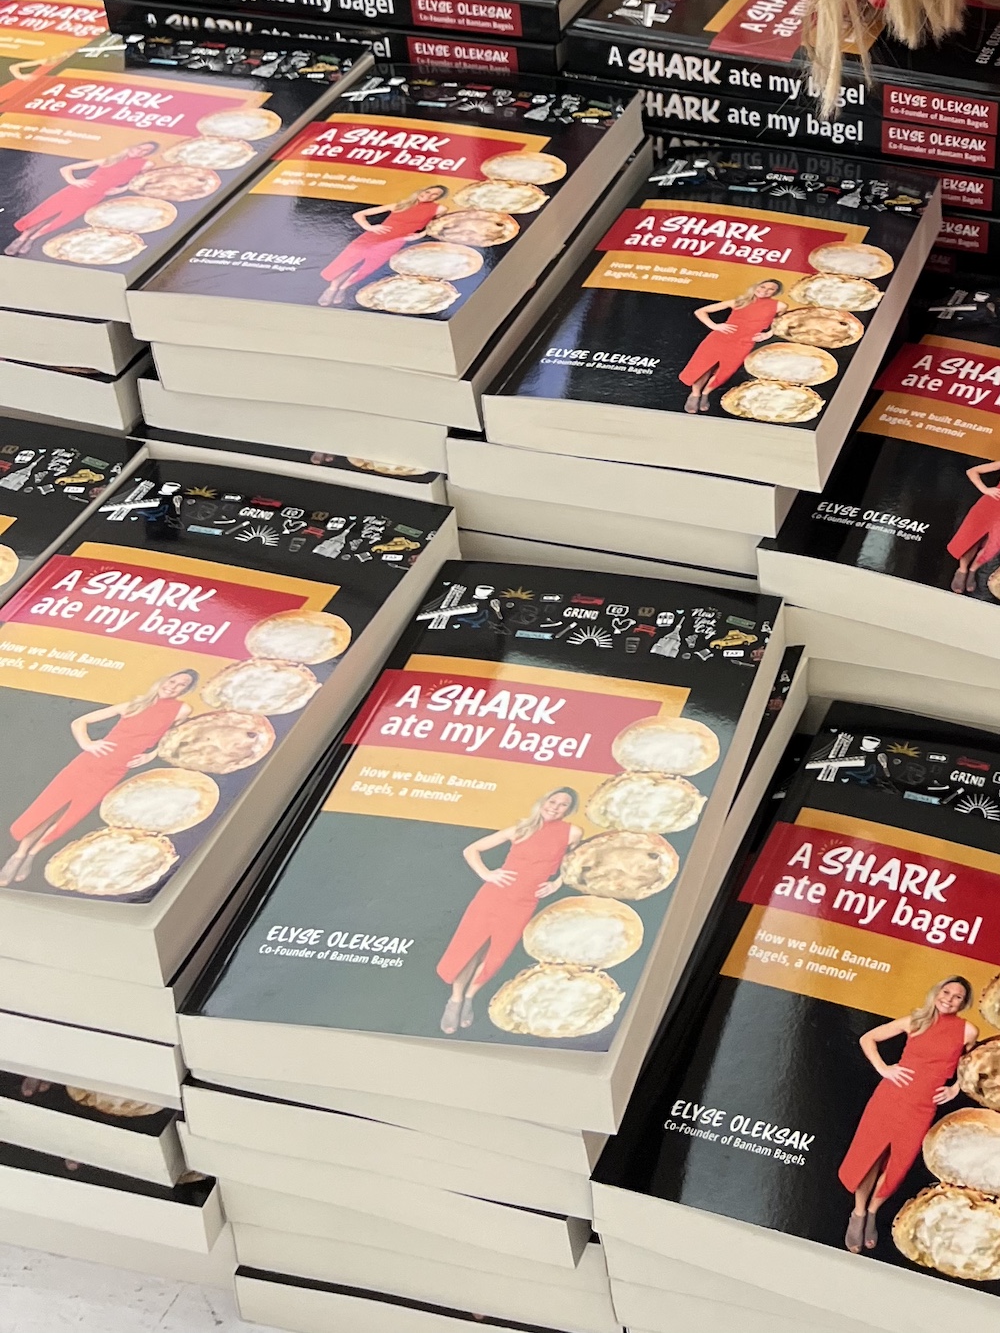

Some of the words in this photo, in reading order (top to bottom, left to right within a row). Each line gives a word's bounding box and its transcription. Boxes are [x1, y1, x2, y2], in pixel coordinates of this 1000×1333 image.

[0, 2, 19, 15] A
[17, 2, 108, 23] SHARK
[0, 14, 20, 26] te
[19, 17, 57, 32] my
[54, 19, 107, 37] bage
[457, 2, 513, 20] OLEKSAK
[739, 22, 768, 34] A
[772, 16, 803, 38] ate
[607, 45, 624, 68] A
[627, 47, 722, 85] SHARK
[728, 68, 763, 89] ate
[768, 73, 802, 100] my
[40, 83, 65, 96] A
[65, 84, 173, 108] SHARK
[889, 91, 928, 109] ELYSE
[931, 97, 990, 118] OLEKSAK
[24, 97, 67, 111] ate
[67, 103, 113, 120] my
[110, 105, 185, 127] bagel
[727, 106, 762, 128] ate
[767, 112, 800, 138] my
[806, 112, 865, 145] bagel
[313, 128, 338, 142] A
[338, 127, 450, 152] SHARK
[888, 126, 926, 143] ELYSE
[929, 132, 987, 153] OLEKSAK
[300, 142, 344, 157] ate
[345, 147, 391, 164] my
[391, 149, 466, 171] bagel
[634, 215, 655, 231] A
[659, 214, 771, 243] SHARK
[195, 247, 240, 259] ELYSE
[238, 250, 307, 265] OLEKSAK
[624, 231, 667, 247] ate
[671, 236, 716, 255] my
[718, 238, 792, 263] bagel
[545, 346, 590, 360] ELYSE
[592, 350, 660, 368] OLEKSAK
[911, 354, 933, 371] A
[900, 373, 943, 391] ate
[947, 381, 992, 405] my
[816, 499, 860, 518] ELYSE
[862, 508, 929, 533] OLEKSAK
[50, 569, 82, 591] A
[80, 570, 216, 612] SHARK
[28, 595, 83, 618] ate
[83, 604, 140, 633] my
[138, 608, 230, 645] bagel
[393, 684, 421, 709] A
[425, 684, 566, 724] SHARK
[379, 713, 434, 738] ate
[438, 721, 495, 752] my
[498, 722, 592, 761] bagel
[358, 766, 389, 778] How
[391, 771, 412, 781] we
[413, 770, 445, 784] built
[445, 775, 497, 791] Bantam
[949, 769, 986, 787] GRIND
[786, 842, 812, 869] A
[817, 845, 956, 902] SHARK
[773, 875, 826, 904] ate
[832, 888, 887, 924] my
[890, 895, 983, 944] bagel
[265, 925, 325, 945] ELYSE
[325, 930, 414, 954] OLEKSAK
[754, 928, 785, 945] How
[786, 938, 807, 951] we
[807, 940, 839, 959] built
[840, 949, 891, 973] Bantam
[747, 944, 792, 966] Bagels,
[793, 958, 803, 968] a
[804, 960, 857, 981] memoir
[670, 1099, 727, 1127] ELYSE
[728, 1114, 815, 1151] OLEKSAK
[663, 1119, 720, 1142] Co-Founder
[719, 1134, 734, 1145] of
[732, 1136, 772, 1156] Bantam
[772, 1147, 805, 1166] Bagels
